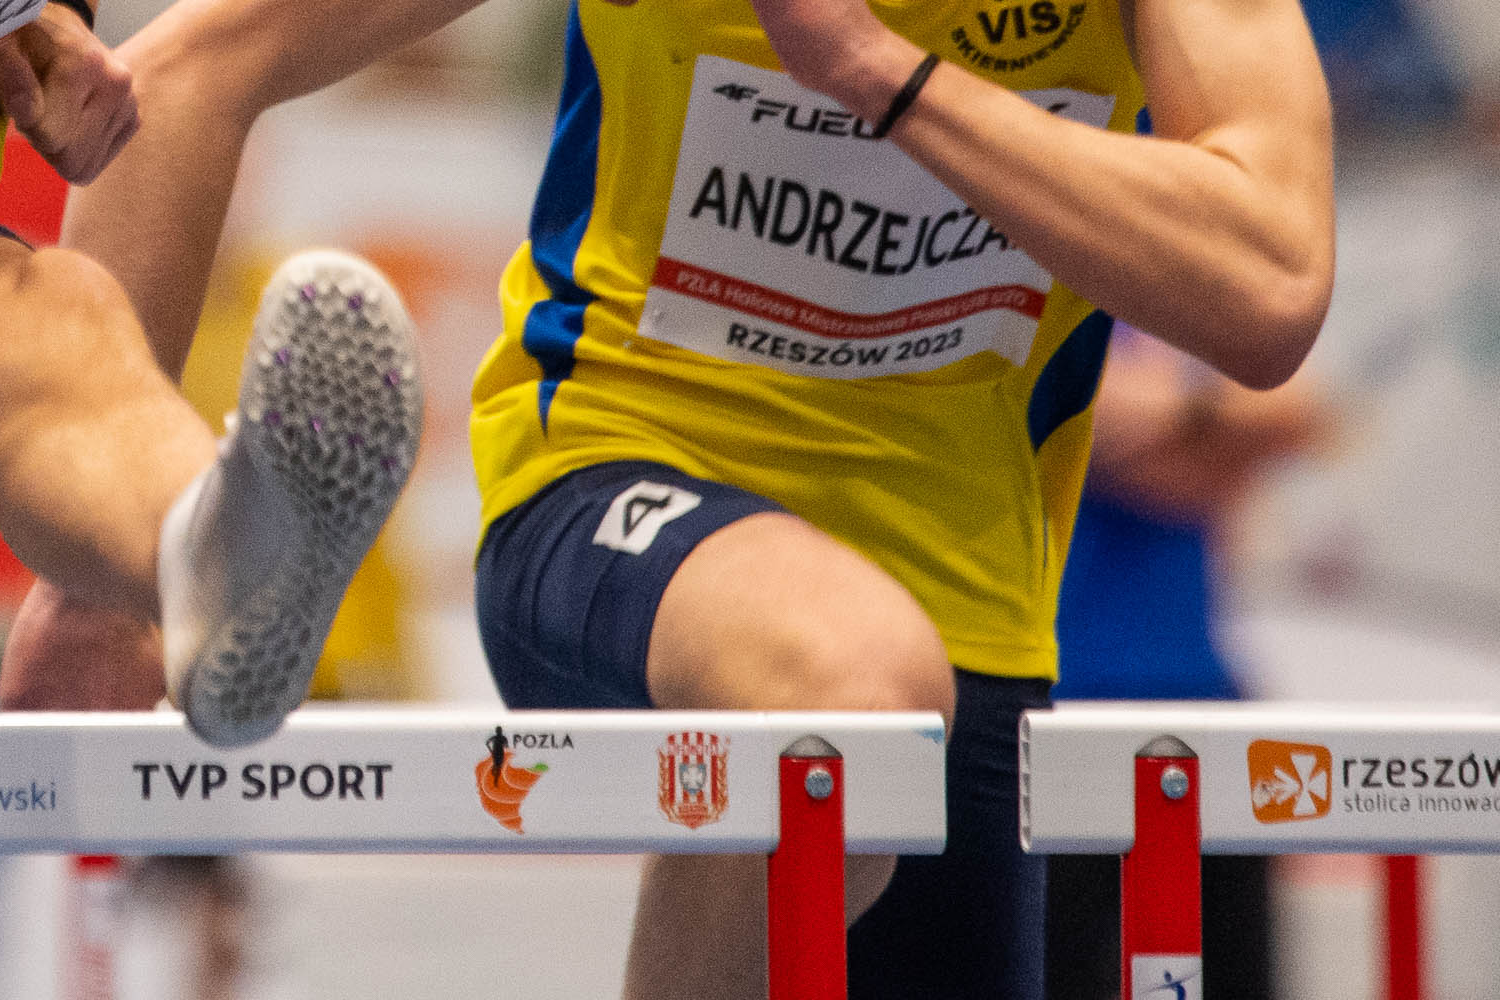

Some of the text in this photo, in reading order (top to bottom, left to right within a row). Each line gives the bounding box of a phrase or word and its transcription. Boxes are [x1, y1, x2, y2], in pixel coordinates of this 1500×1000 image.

[977, 1, 1061, 44] VIS
[689, 166, 1016, 276] ANDRZEJCZA
[727, 323, 963, 366] RZESZÓW 2023
[623, 494, 672, 539] 4
[512, 733, 574, 749] POZLA
[133, 763, 393, 800] TVP SPORT
[1344, 794, 1411, 813] stolica
